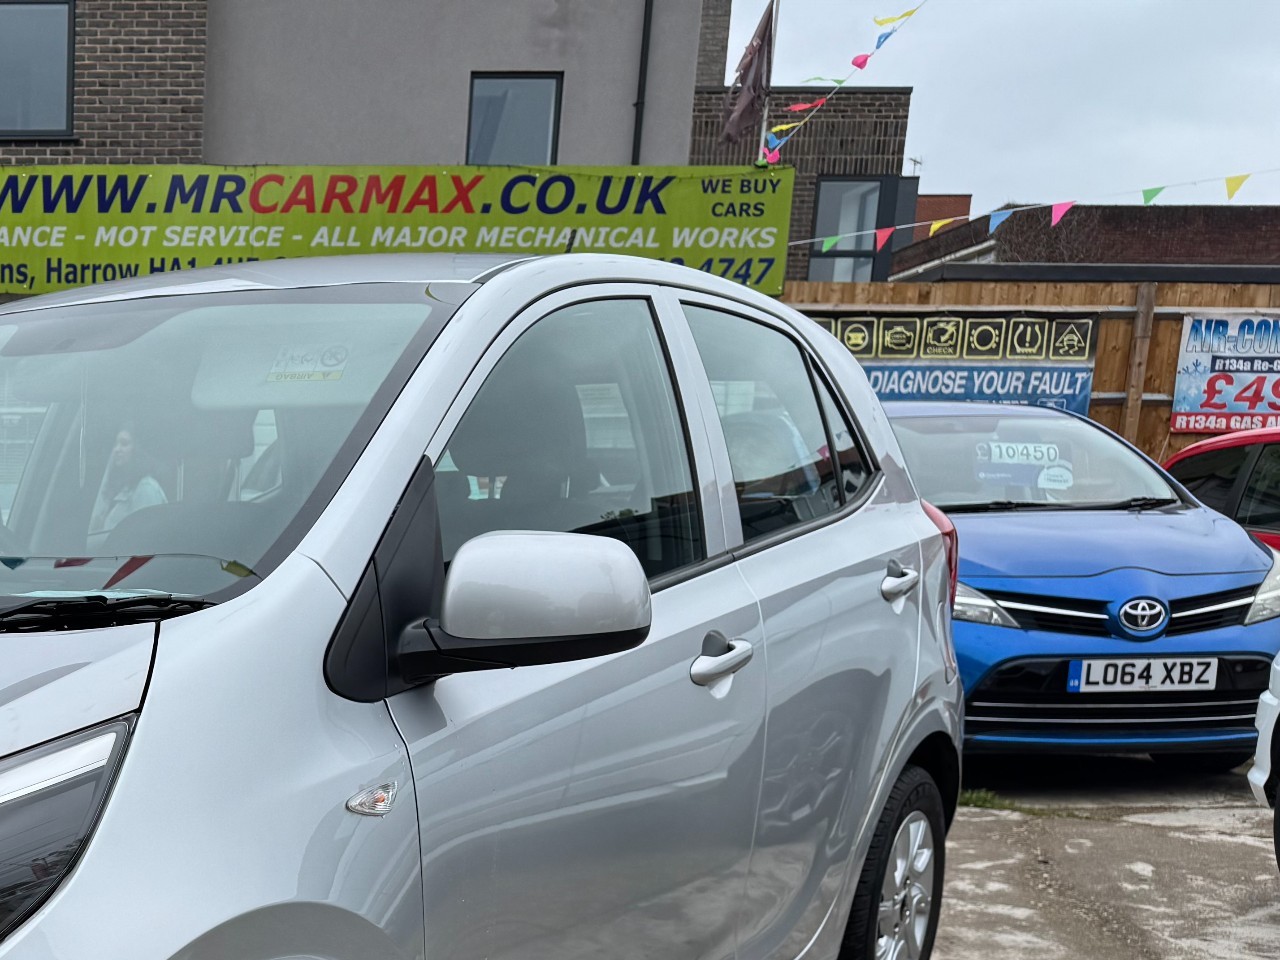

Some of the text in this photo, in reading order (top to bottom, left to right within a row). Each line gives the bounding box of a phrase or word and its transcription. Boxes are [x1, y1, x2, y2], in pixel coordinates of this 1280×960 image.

[701, 179, 781, 194] WE BUY
[711, 202, 765, 217] CARS
[94, 226, 156, 247] MOT
[162, 226, 284, 247] SERVICE
[310, 226, 361, 247] ALL
[370, 226, 466, 247] MAJOR
[475, 226, 660, 248] MECHANICAL
[672, 227, 778, 249] WORKS
[46, 257, 140, 283] Harrow
[1215, 358, 1251, 371] R134a
[870, 370, 1086, 395] DIAGNOSE YOUR FAULT
[1175, 415, 1227, 429] R134a
[1230, 415, 1263, 430] GAS
[1084, 662, 1152, 685] LO64
[1160, 661, 1212, 685] XBZ
